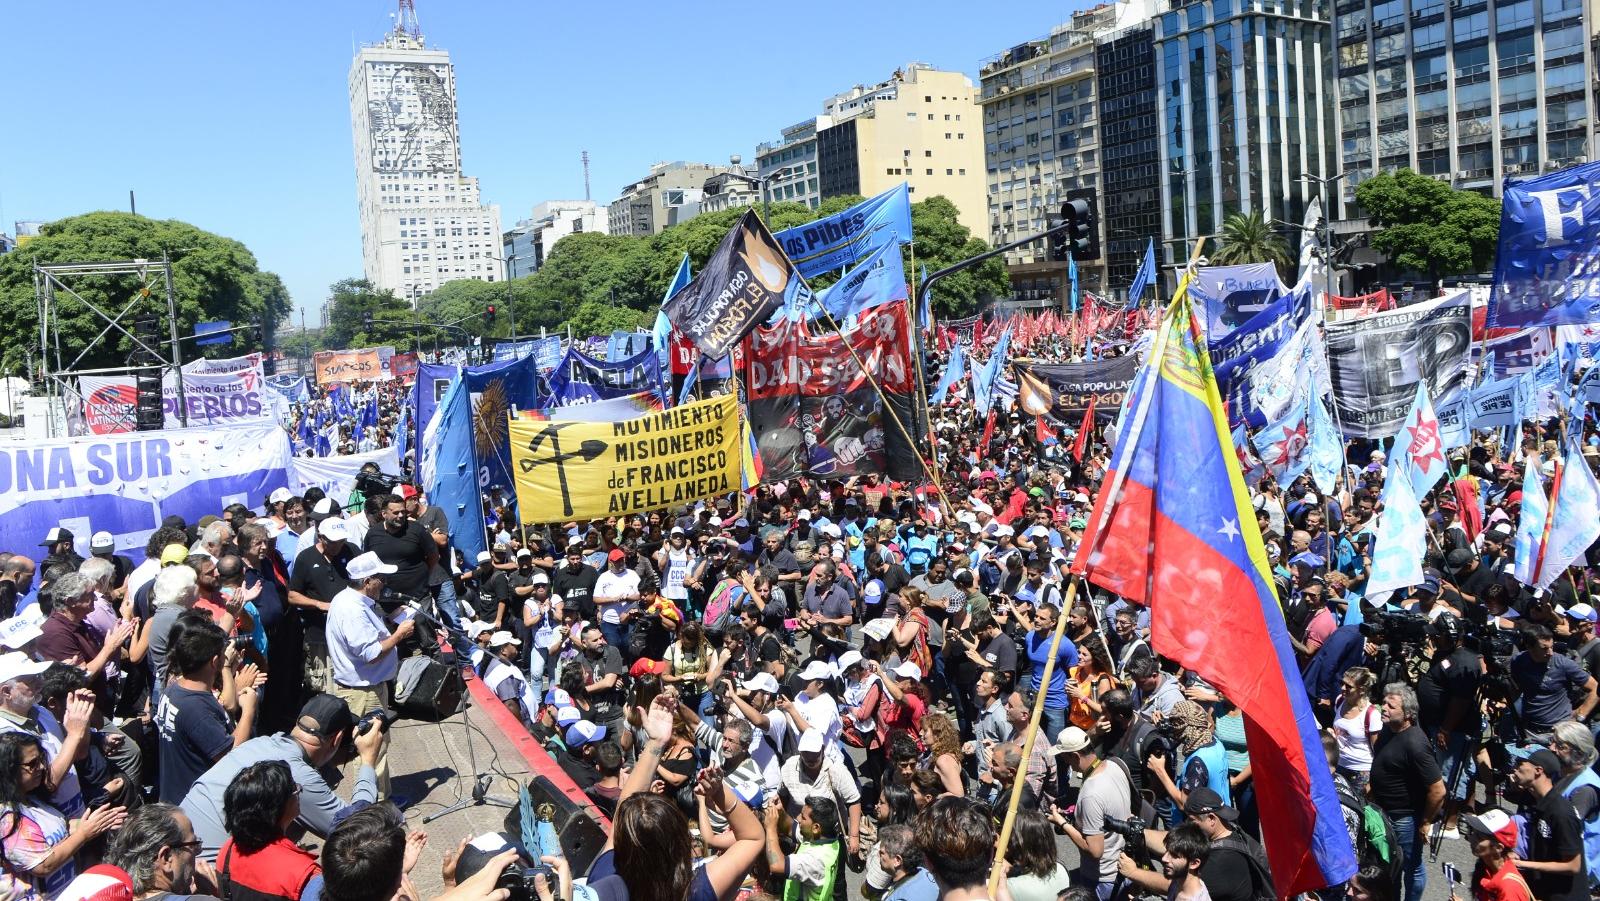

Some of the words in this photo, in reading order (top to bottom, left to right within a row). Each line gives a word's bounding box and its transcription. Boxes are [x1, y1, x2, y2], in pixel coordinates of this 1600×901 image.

[803, 212, 865, 251] Pibes
[213, 385, 226, 393] de
[228, 383, 243, 392] los
[1058, 383, 1081, 393] CASA
[1059, 394, 1079, 406] EL
[162, 391, 262, 420] PUEBLOS
[613, 403, 723, 436] MOVIMIENTO
[615, 425, 724, 462] MISIONEROS
[87, 438, 173, 488] SUR
[607, 470, 624, 489] de
[626, 449, 726, 487] FRANCISCO
[608, 472, 728, 513] AVELLANEDA
[671, 570, 685, 580] CCC
